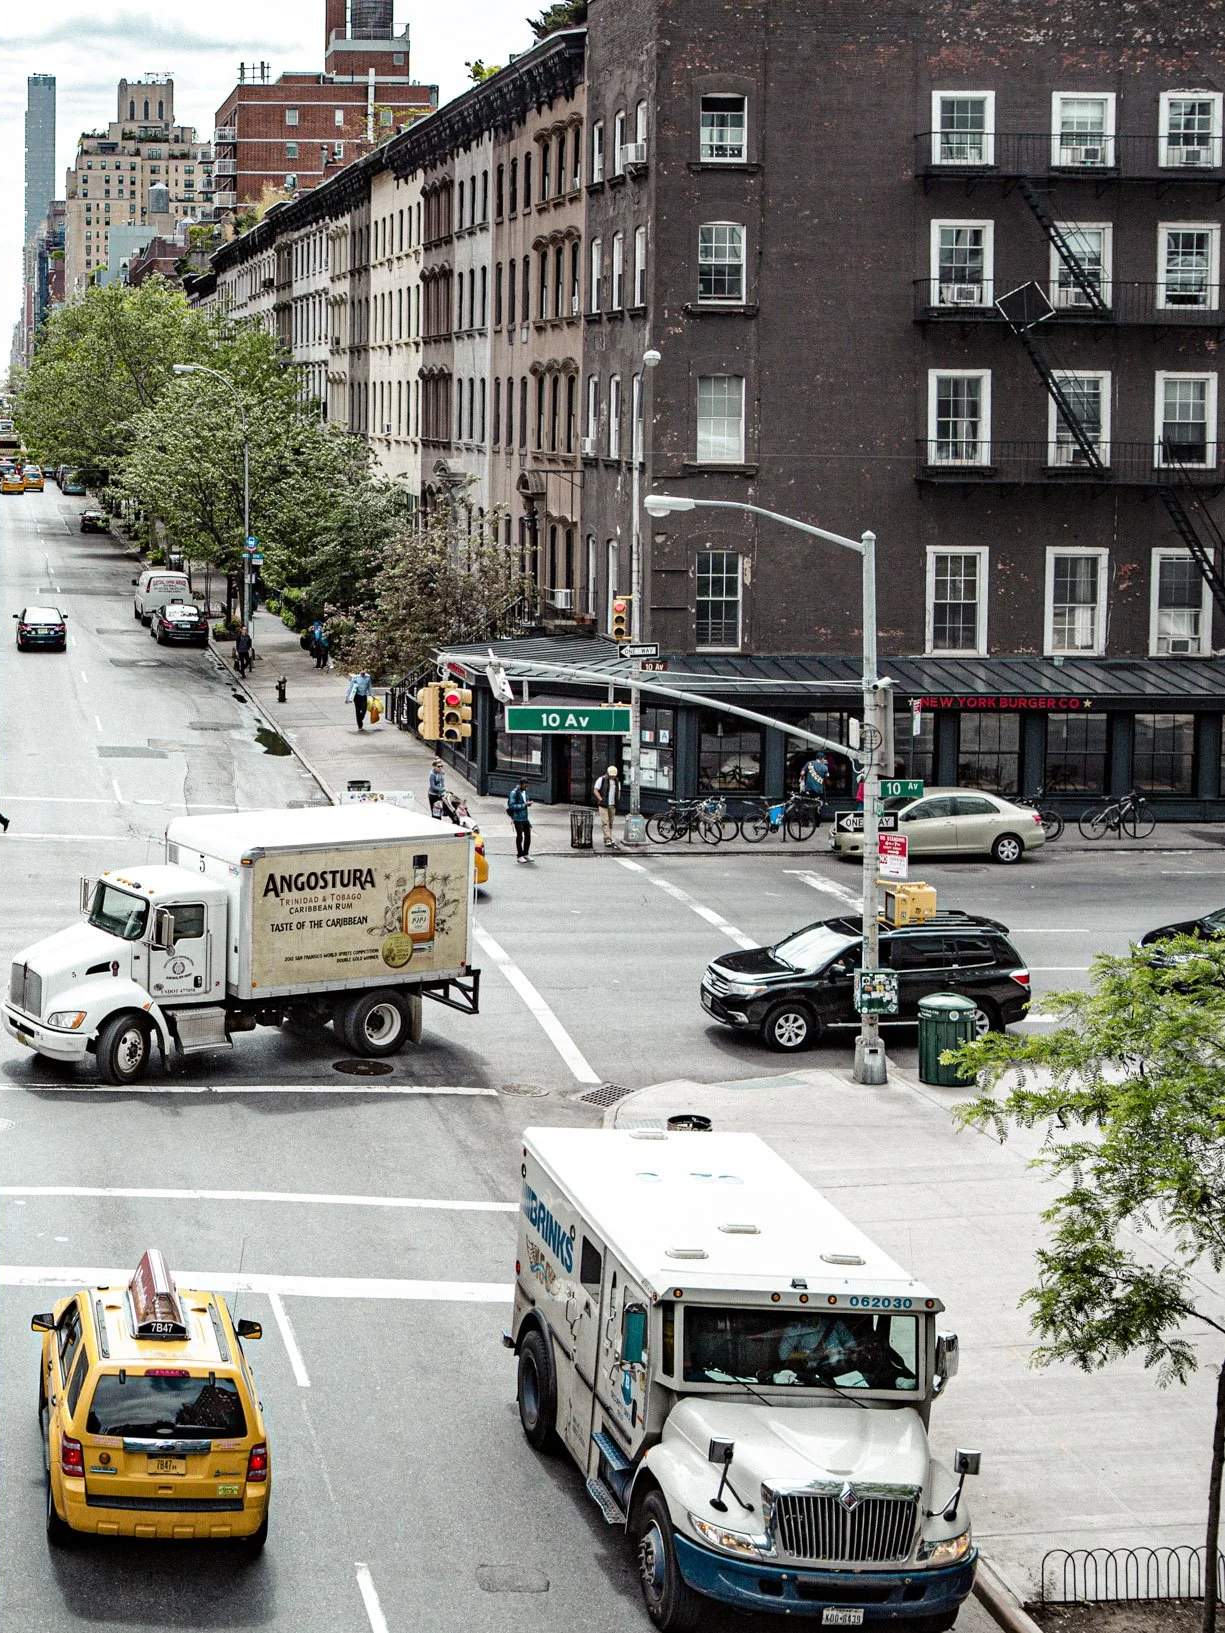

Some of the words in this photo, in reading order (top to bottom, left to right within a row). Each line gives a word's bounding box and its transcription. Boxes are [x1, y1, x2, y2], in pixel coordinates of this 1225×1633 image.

[921, 697, 953, 708] NEW
[957, 697, 996, 708] YORK
[999, 698, 1056, 709] BURGER
[1058, 698, 1080, 709] CO
[541, 713, 560, 727] 10
[564, 713, 590, 727] Av
[886, 782, 901, 795] 10
[846, 818, 863, 827] ONE
[262, 868, 376, 898] ANGOSTURA
[280, 896, 319, 906] TRINIDAD
[330, 893, 362, 901] TOBAGO
[289, 904, 333, 914] CARIBBEAN
[270, 922, 293, 932] TASTE
[296, 921, 306, 930] OF
[309, 920, 323, 929] THE
[326, 916, 368, 928] CARIBBEAN
[849, 1296, 912, 1309] 062030
[151, 1323, 173, 1333] 7B47
